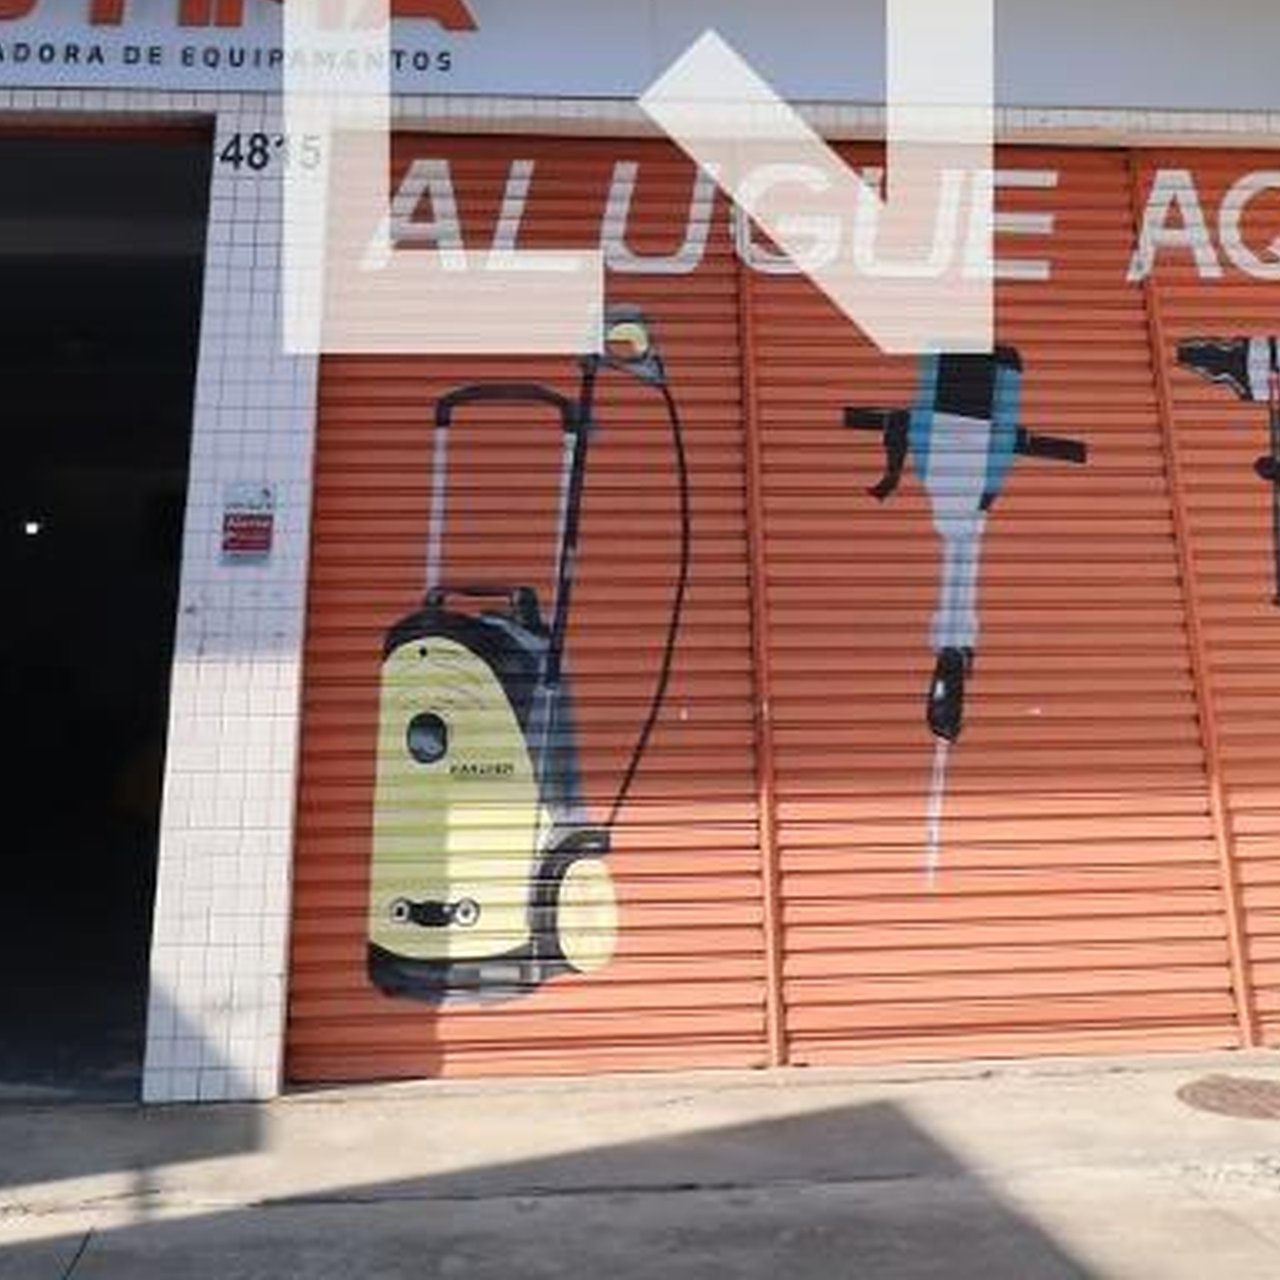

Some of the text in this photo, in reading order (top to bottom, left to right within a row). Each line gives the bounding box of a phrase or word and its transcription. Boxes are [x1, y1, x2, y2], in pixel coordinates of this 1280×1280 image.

[124, 44, 162, 66] DE
[181, 44, 453, 72] EQUIPAMENTOS
[219, 132, 322, 171] 4815
[360, 158, 1060, 280] ALUGUE
